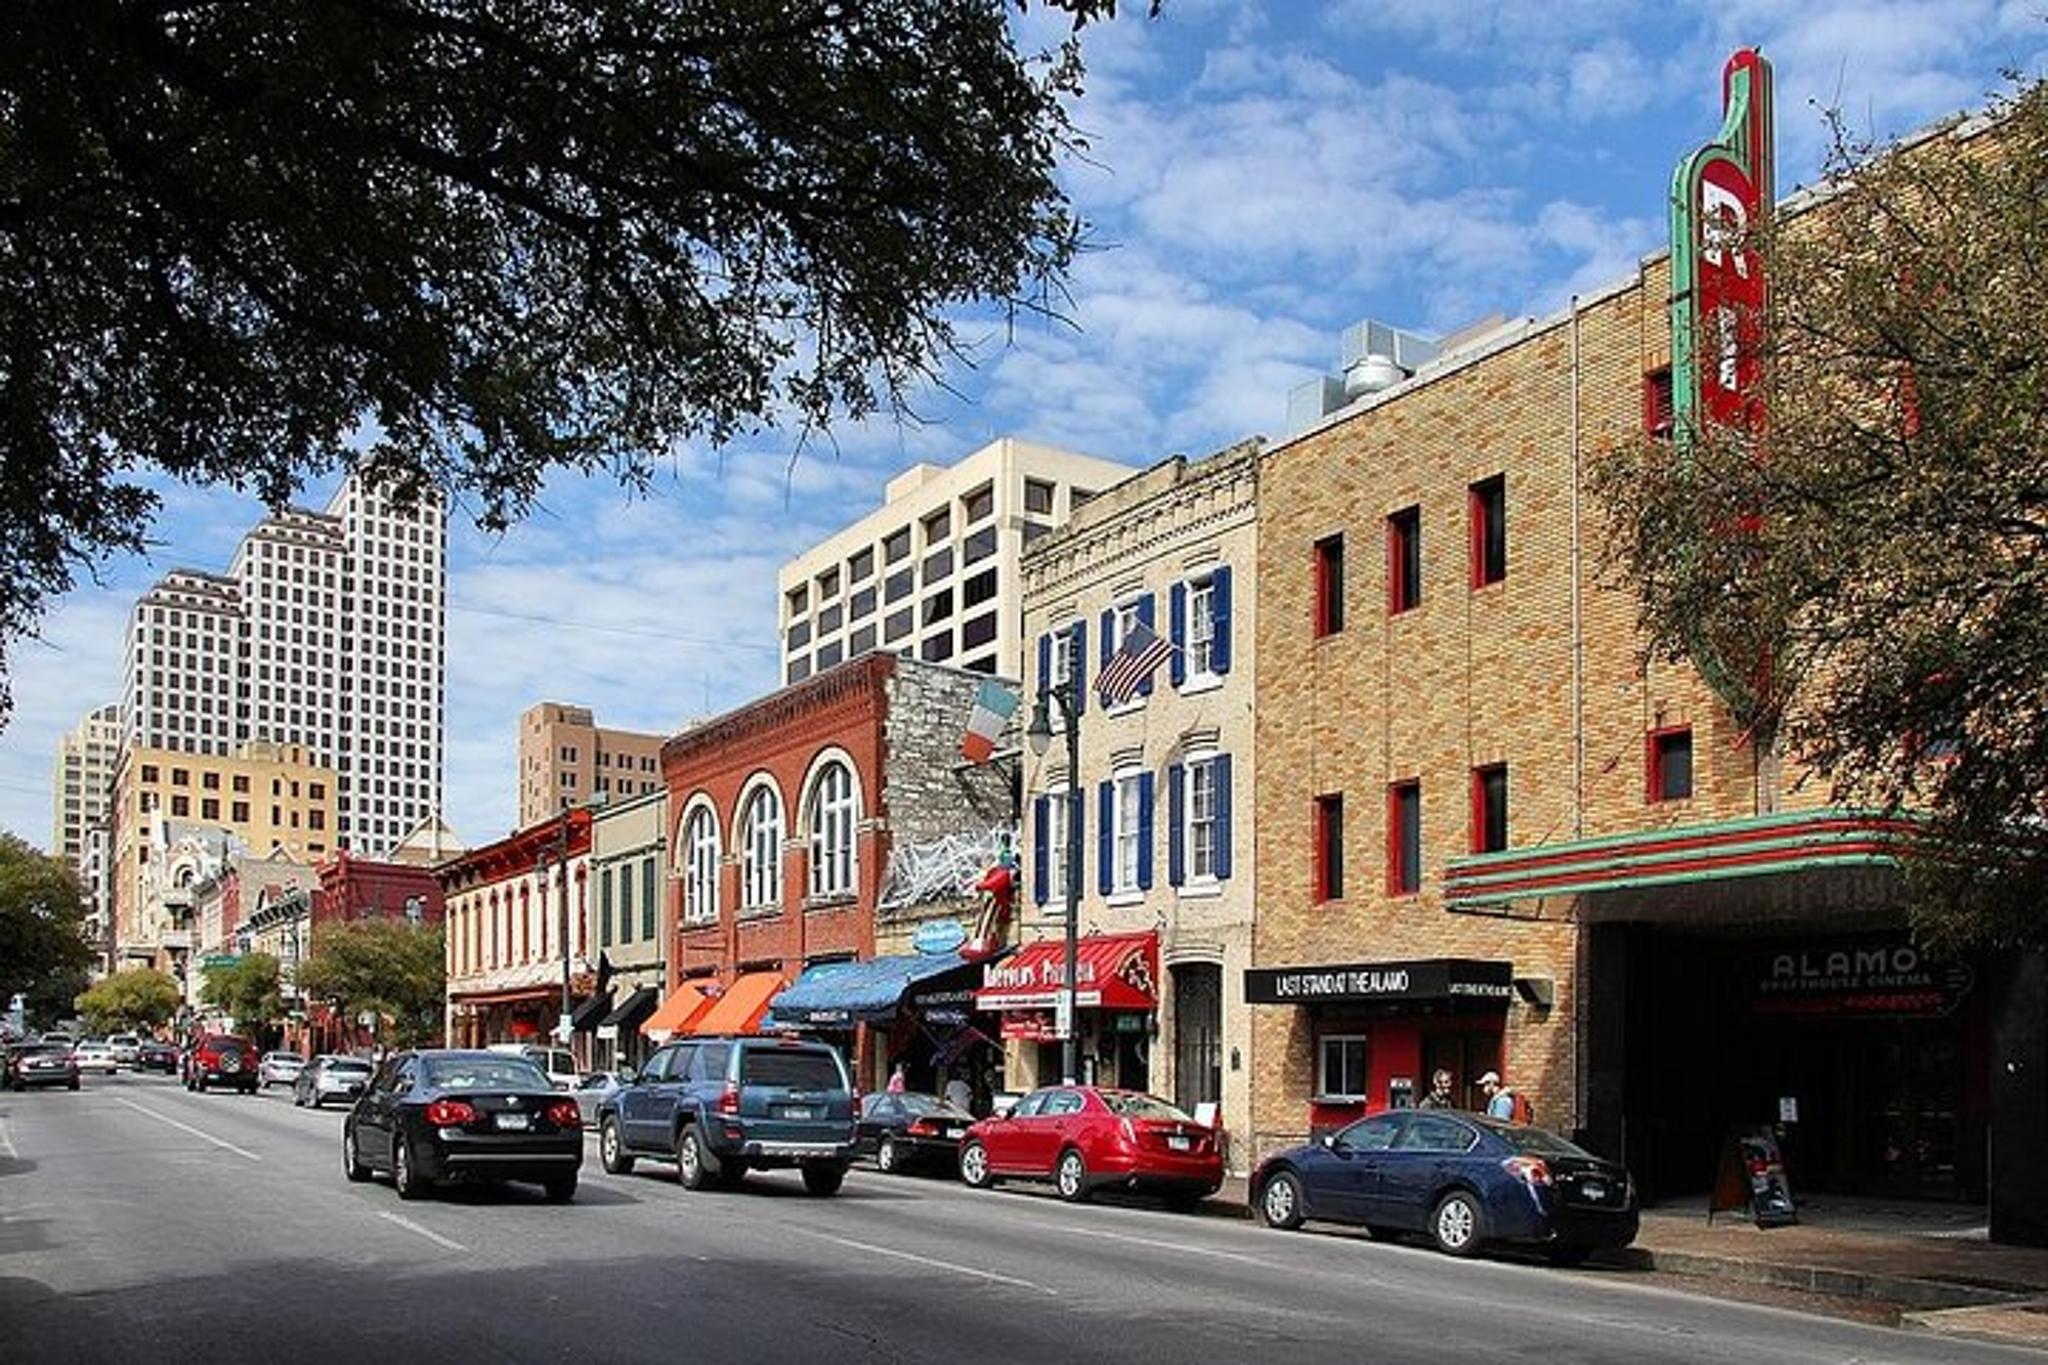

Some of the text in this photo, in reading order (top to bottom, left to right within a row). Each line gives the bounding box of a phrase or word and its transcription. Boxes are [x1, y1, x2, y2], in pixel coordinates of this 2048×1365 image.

[1773, 949, 1917, 977] ALAMO
[1277, 974, 1301, 996] LAST
[1302, 973, 1334, 995] STAND
[1347, 971, 1369, 993] THE
[1369, 969, 1409, 992] ALAMO
[1868, 973, 1932, 987] CINEMA
